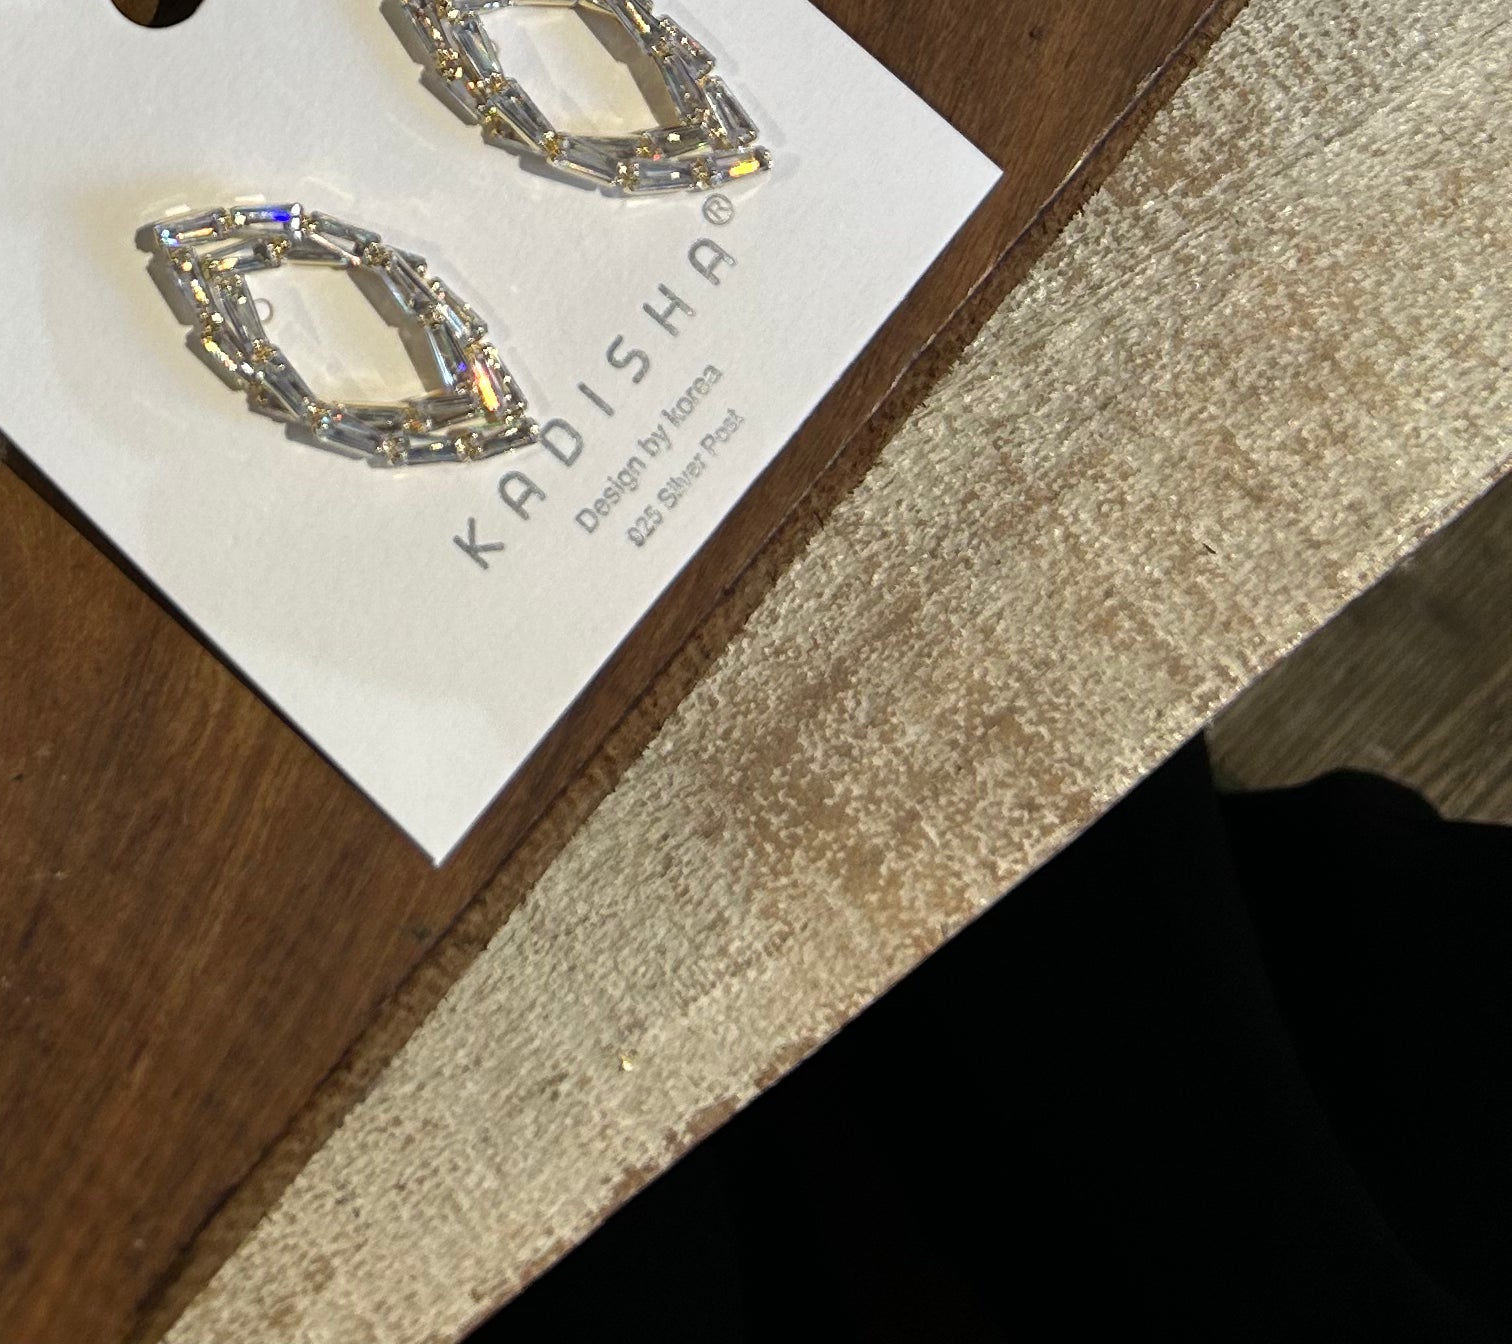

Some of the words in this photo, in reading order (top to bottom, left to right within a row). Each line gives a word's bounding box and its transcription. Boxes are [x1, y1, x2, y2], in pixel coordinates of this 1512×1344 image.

[575, 456, 647, 534] Design
[637, 423, 673, 457] by
[661, 364, 723, 428] korea
[627, 504, 664, 547] 925
[656, 453, 707, 510] Silver
[699, 408, 745, 457] Post
